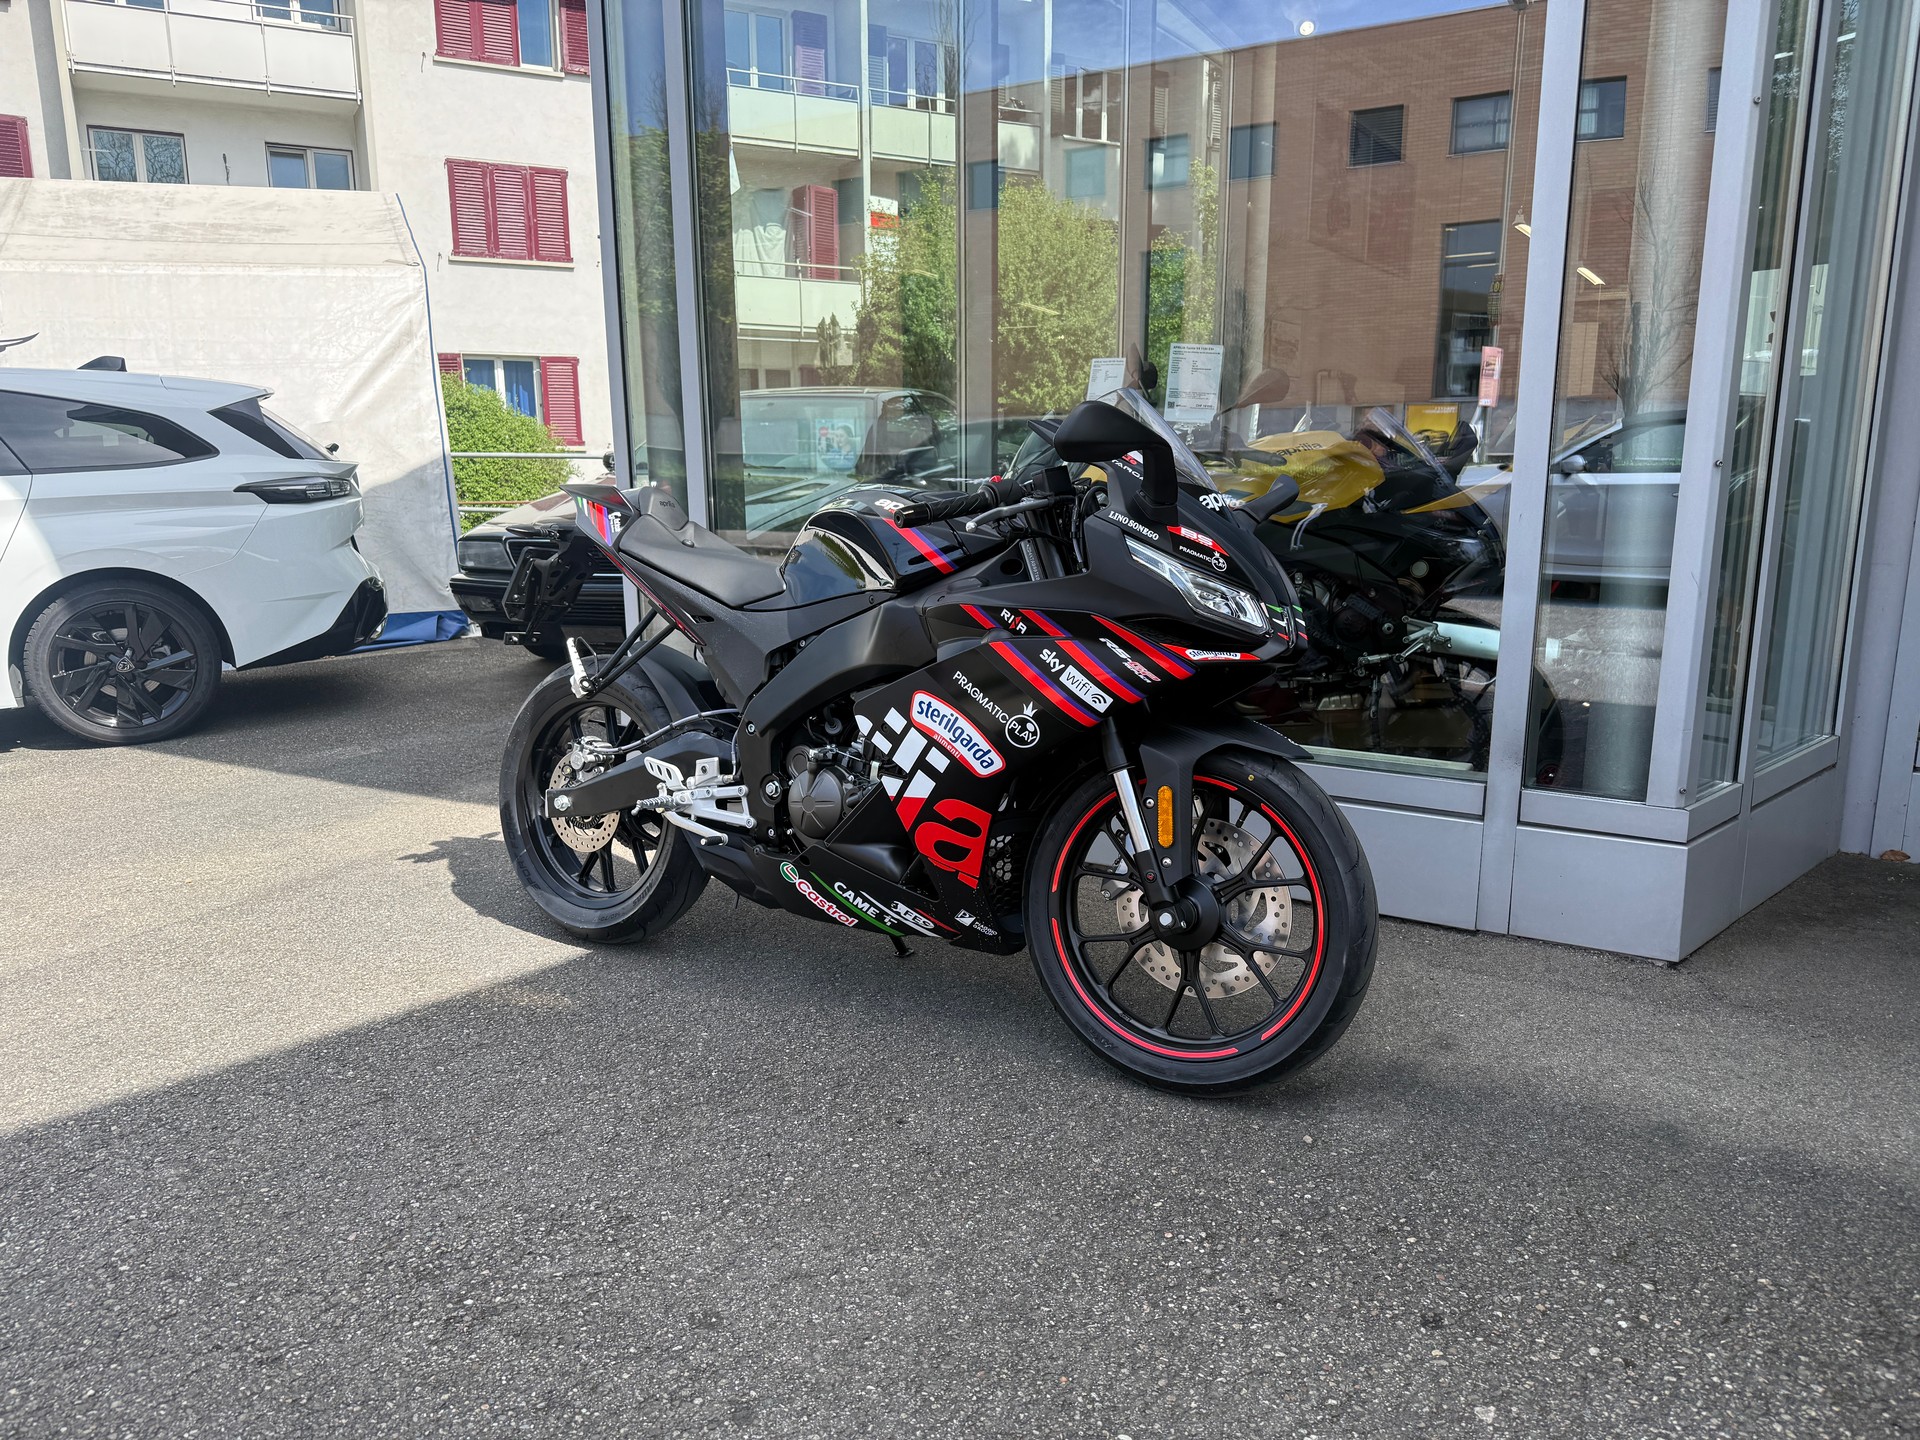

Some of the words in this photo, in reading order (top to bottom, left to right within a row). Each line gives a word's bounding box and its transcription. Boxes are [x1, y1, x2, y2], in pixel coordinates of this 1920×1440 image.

[1108, 511, 1129, 525] LINO
[1127, 520, 1160, 541] SONEGO
[1179, 545, 1213, 563] PRAGMATIC
[1000, 608, 1028, 635] RINA
[1038, 648, 1066, 673] sky
[1066, 670, 1093, 697] wifi
[952, 670, 1010, 725] PRAGMATIC
[1009, 719, 1038, 745] PLAY
[916, 699, 995, 770] sterilgarda
[933, 733, 962, 759] alimenti
[795, 879, 859, 927] Castrol
[833, 881, 880, 919] CAME
